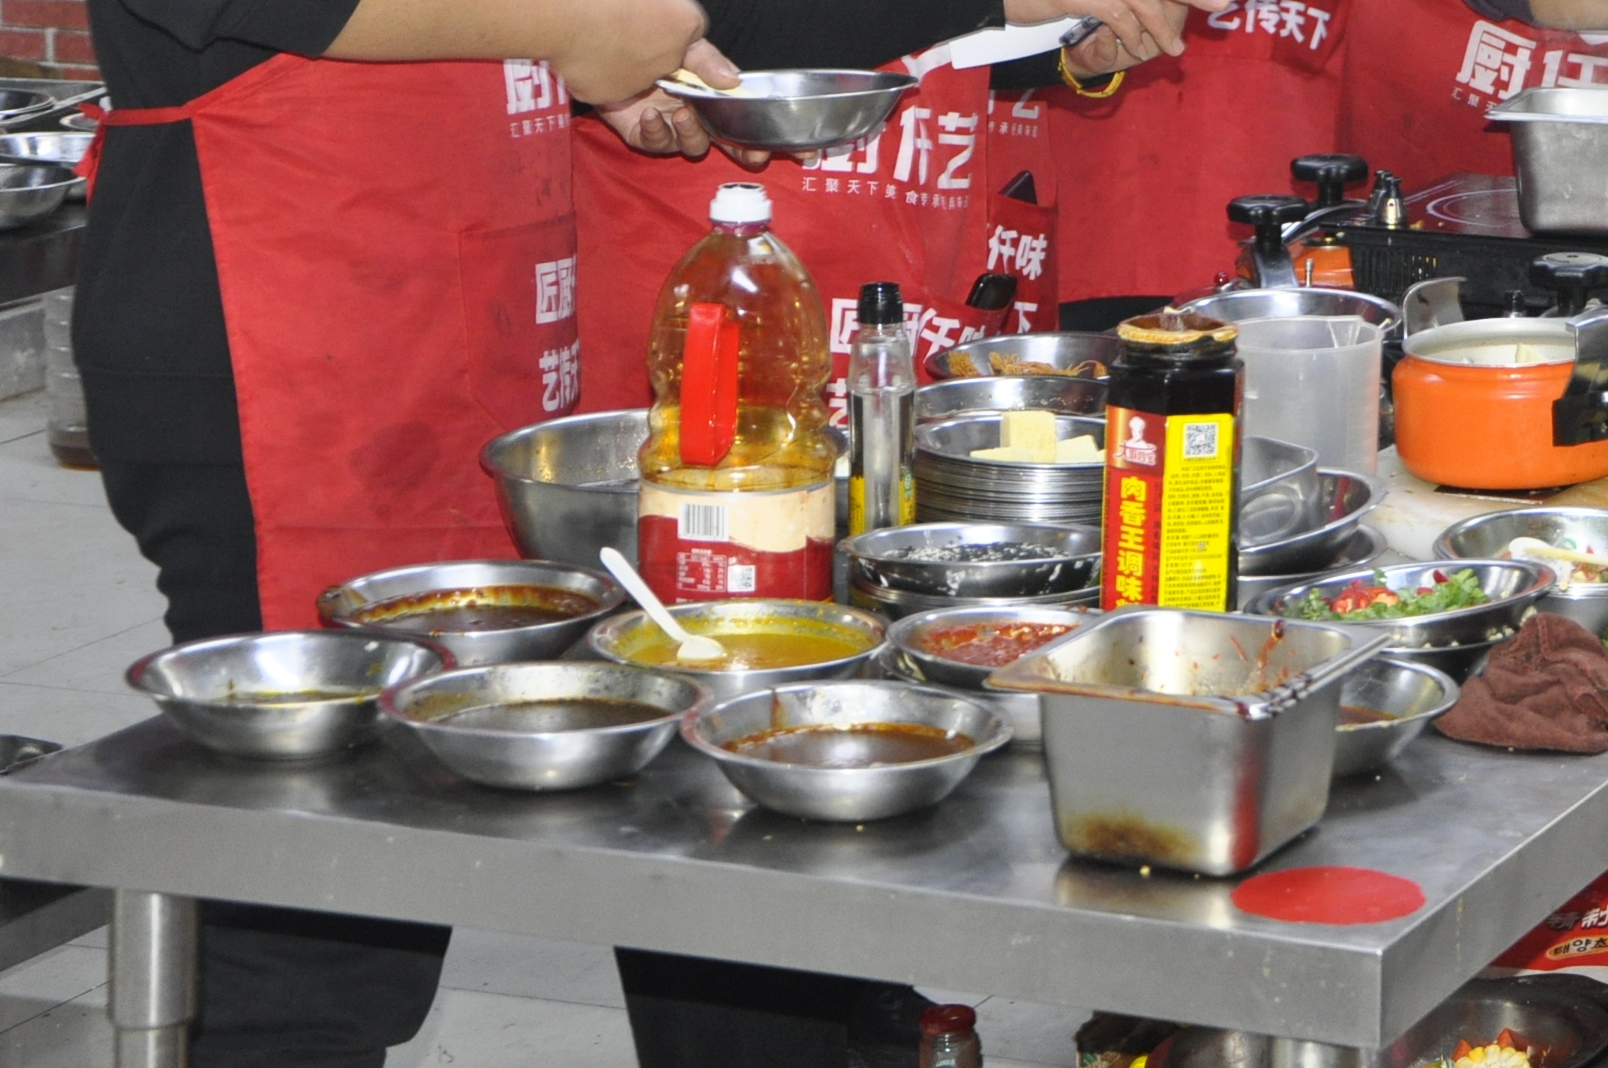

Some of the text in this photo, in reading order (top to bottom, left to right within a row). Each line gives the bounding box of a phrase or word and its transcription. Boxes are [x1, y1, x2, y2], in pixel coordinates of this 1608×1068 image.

[802, 176, 918, 206] 汇聚天下美食
[987, 225, 1048, 281] 仟味
